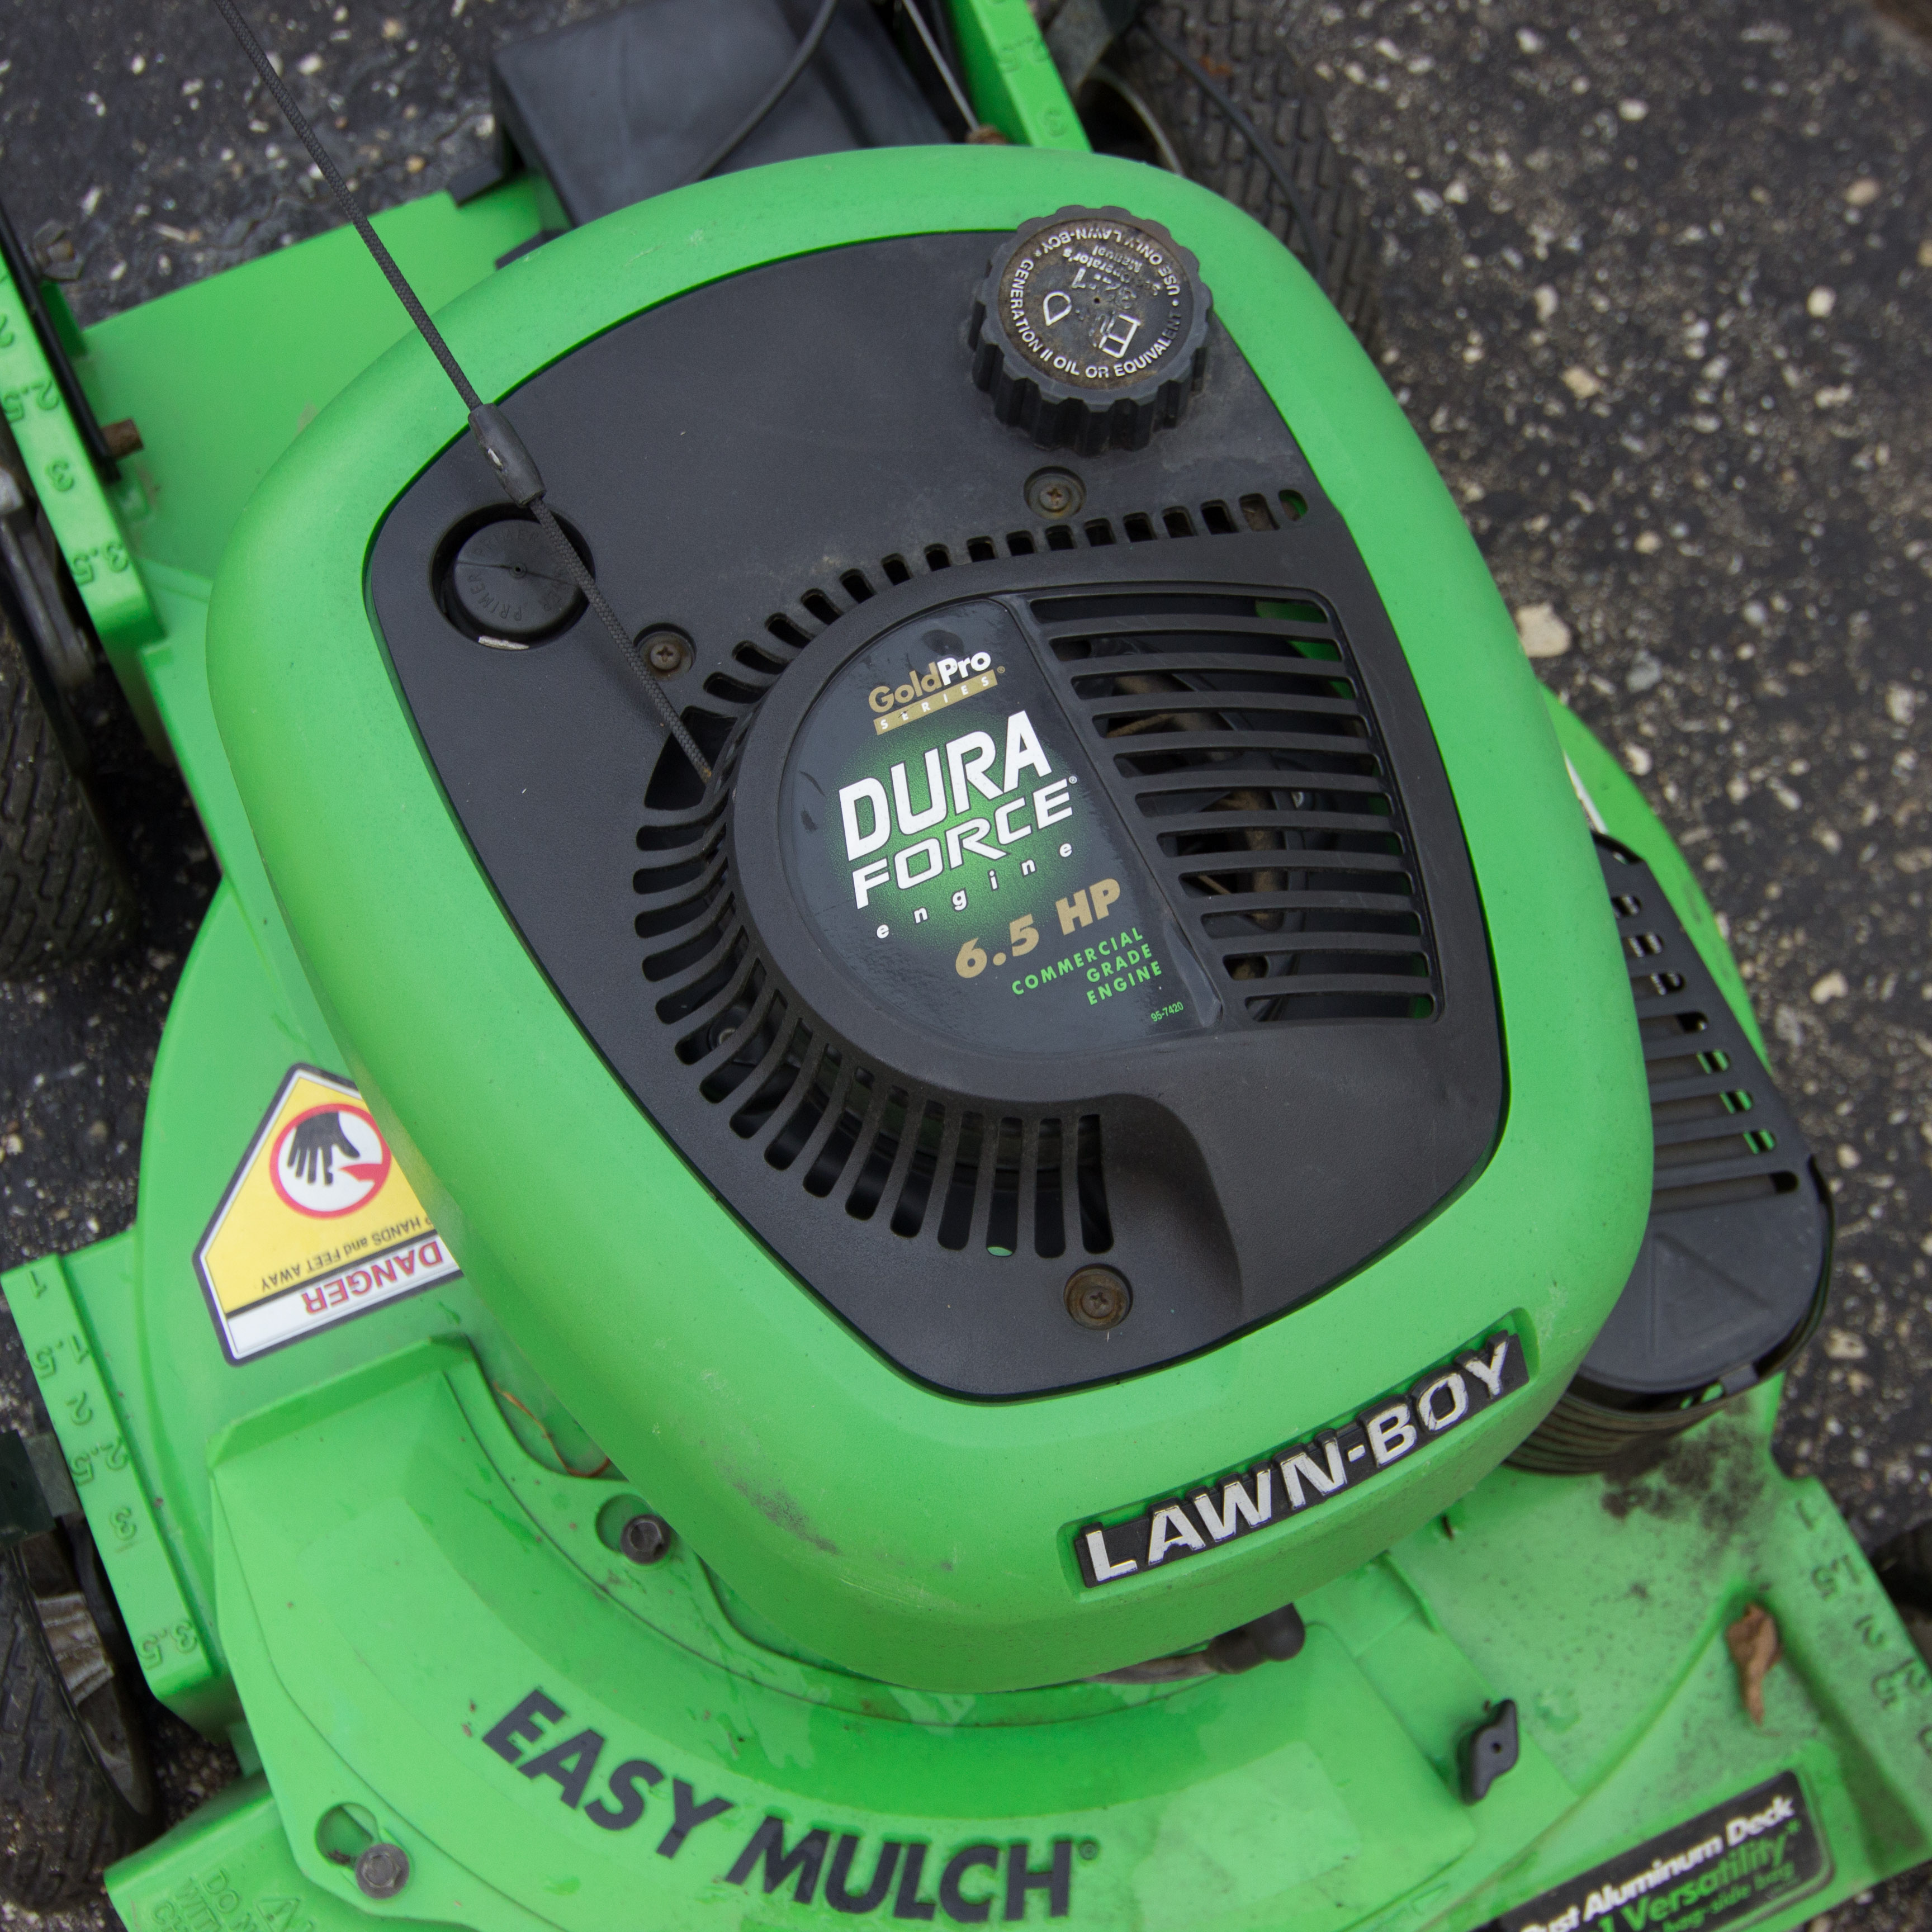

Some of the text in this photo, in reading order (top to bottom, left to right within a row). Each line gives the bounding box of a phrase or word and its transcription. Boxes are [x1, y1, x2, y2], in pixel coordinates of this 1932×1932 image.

[1124, 236, 1163, 266] ONLY
[1158, 265, 1181, 296] USE
[1010, 259, 1044, 352] GENERATION
[1053, 356, 1080, 376] OIL
[1085, 365, 1110, 378] OR
[1114, 311, 1182, 377] EQUIVALENT
[3, 380, 60, 424] 2.5
[46, 460, 75, 493] 3
[71, 541, 130, 585] 3.5
[468, 573, 523, 621] PRIMER
[868, 652, 991, 713] GoldPro
[880, 676, 989, 730] SERIES
[839, 710, 1052, 861] DURA
[852, 778, 1073, 910] FORCE
[876, 842, 1072, 939] engine
[955, 878, 1121, 978] 6.5 HP
[1012, 927, 1143, 995] COMMERCIAL
[1087, 943, 1152, 982] GRADE
[1087, 960, 1162, 1005] ENGINE
[1150, 1001, 1184, 1022] 95-7420
[344, 1237, 368, 1256] and
[372, 1216, 421, 1245] HANDS
[262, 1264, 300, 1291] AWAY
[301, 1240, 443, 1314] DANGER
[307, 1248, 341, 1271] FEET
[28, 1270, 48, 1299] 1
[34, 1334, 91, 1379] 1.5
[65, 1391, 94, 1427] 2
[69, 1435, 129, 1486] 2.5
[1083, 1335, 1510, 1583] LAWN-BOY
[110, 1505, 138, 1541] 3
[138, 1618, 198, 1670] 3.5
[481, 1688, 1072, 1924] EASY MULCH
[1583, 1835, 1723, 1922] Aluminum
[1725, 1794, 1795, 1846] Deck
[202, 1869, 240, 1915] DO
